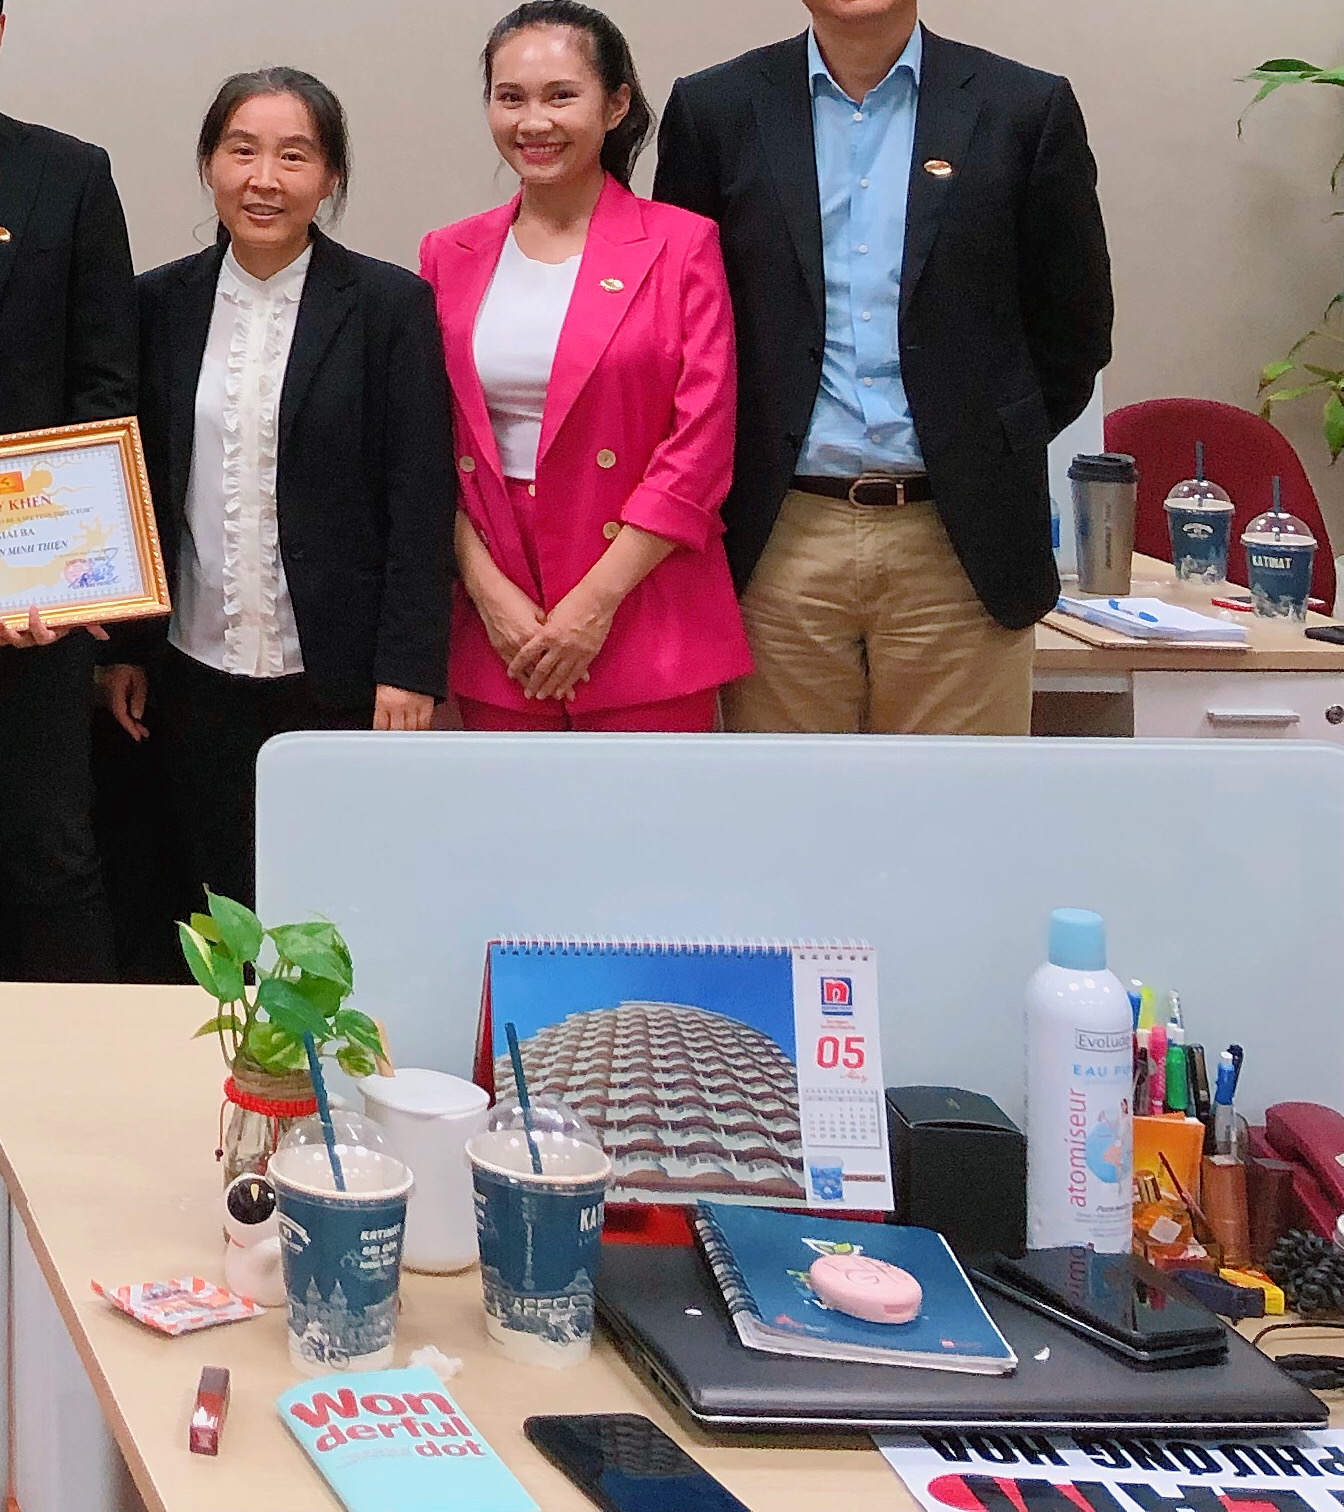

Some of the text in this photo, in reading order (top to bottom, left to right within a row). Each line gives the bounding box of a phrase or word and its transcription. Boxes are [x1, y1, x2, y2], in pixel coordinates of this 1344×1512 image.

[7, 494, 53, 512] KHEN
[20, 527, 36, 537] BA
[7, 544, 35, 556] MINH
[816, 1034, 866, 1069] 05
[1073, 1063, 1108, 1078] EAU
[1064, 1087, 1088, 1208] atomiseur
[289, 1387, 457, 1429] Won
[315, 1415, 473, 1453] derful
[920, 1427, 1070, 1467] HOA
[414, 1439, 488, 1458] dot
